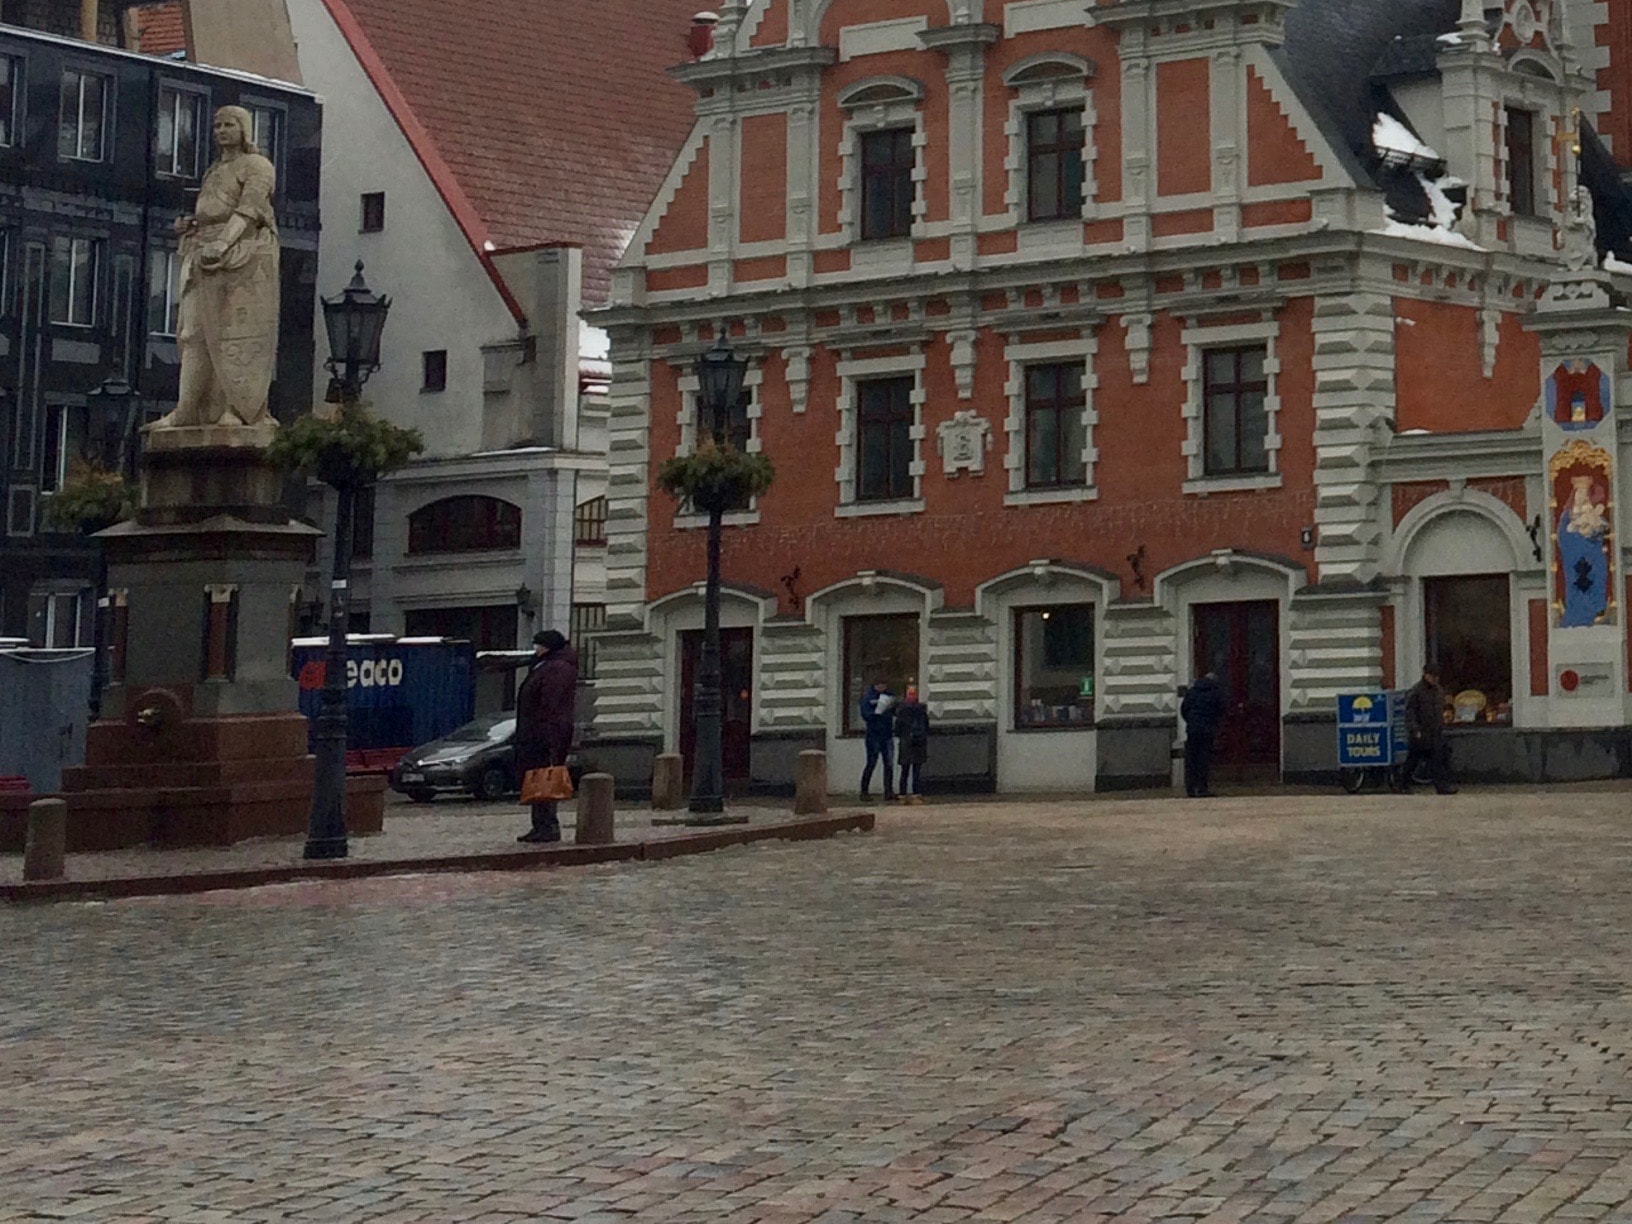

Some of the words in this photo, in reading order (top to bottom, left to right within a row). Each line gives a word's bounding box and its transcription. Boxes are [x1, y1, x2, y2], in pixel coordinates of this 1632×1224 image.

[346, 659, 403, 687] eaco
[1347, 732, 1380, 744] DAILY
[1347, 746, 1380, 758] TOURS
